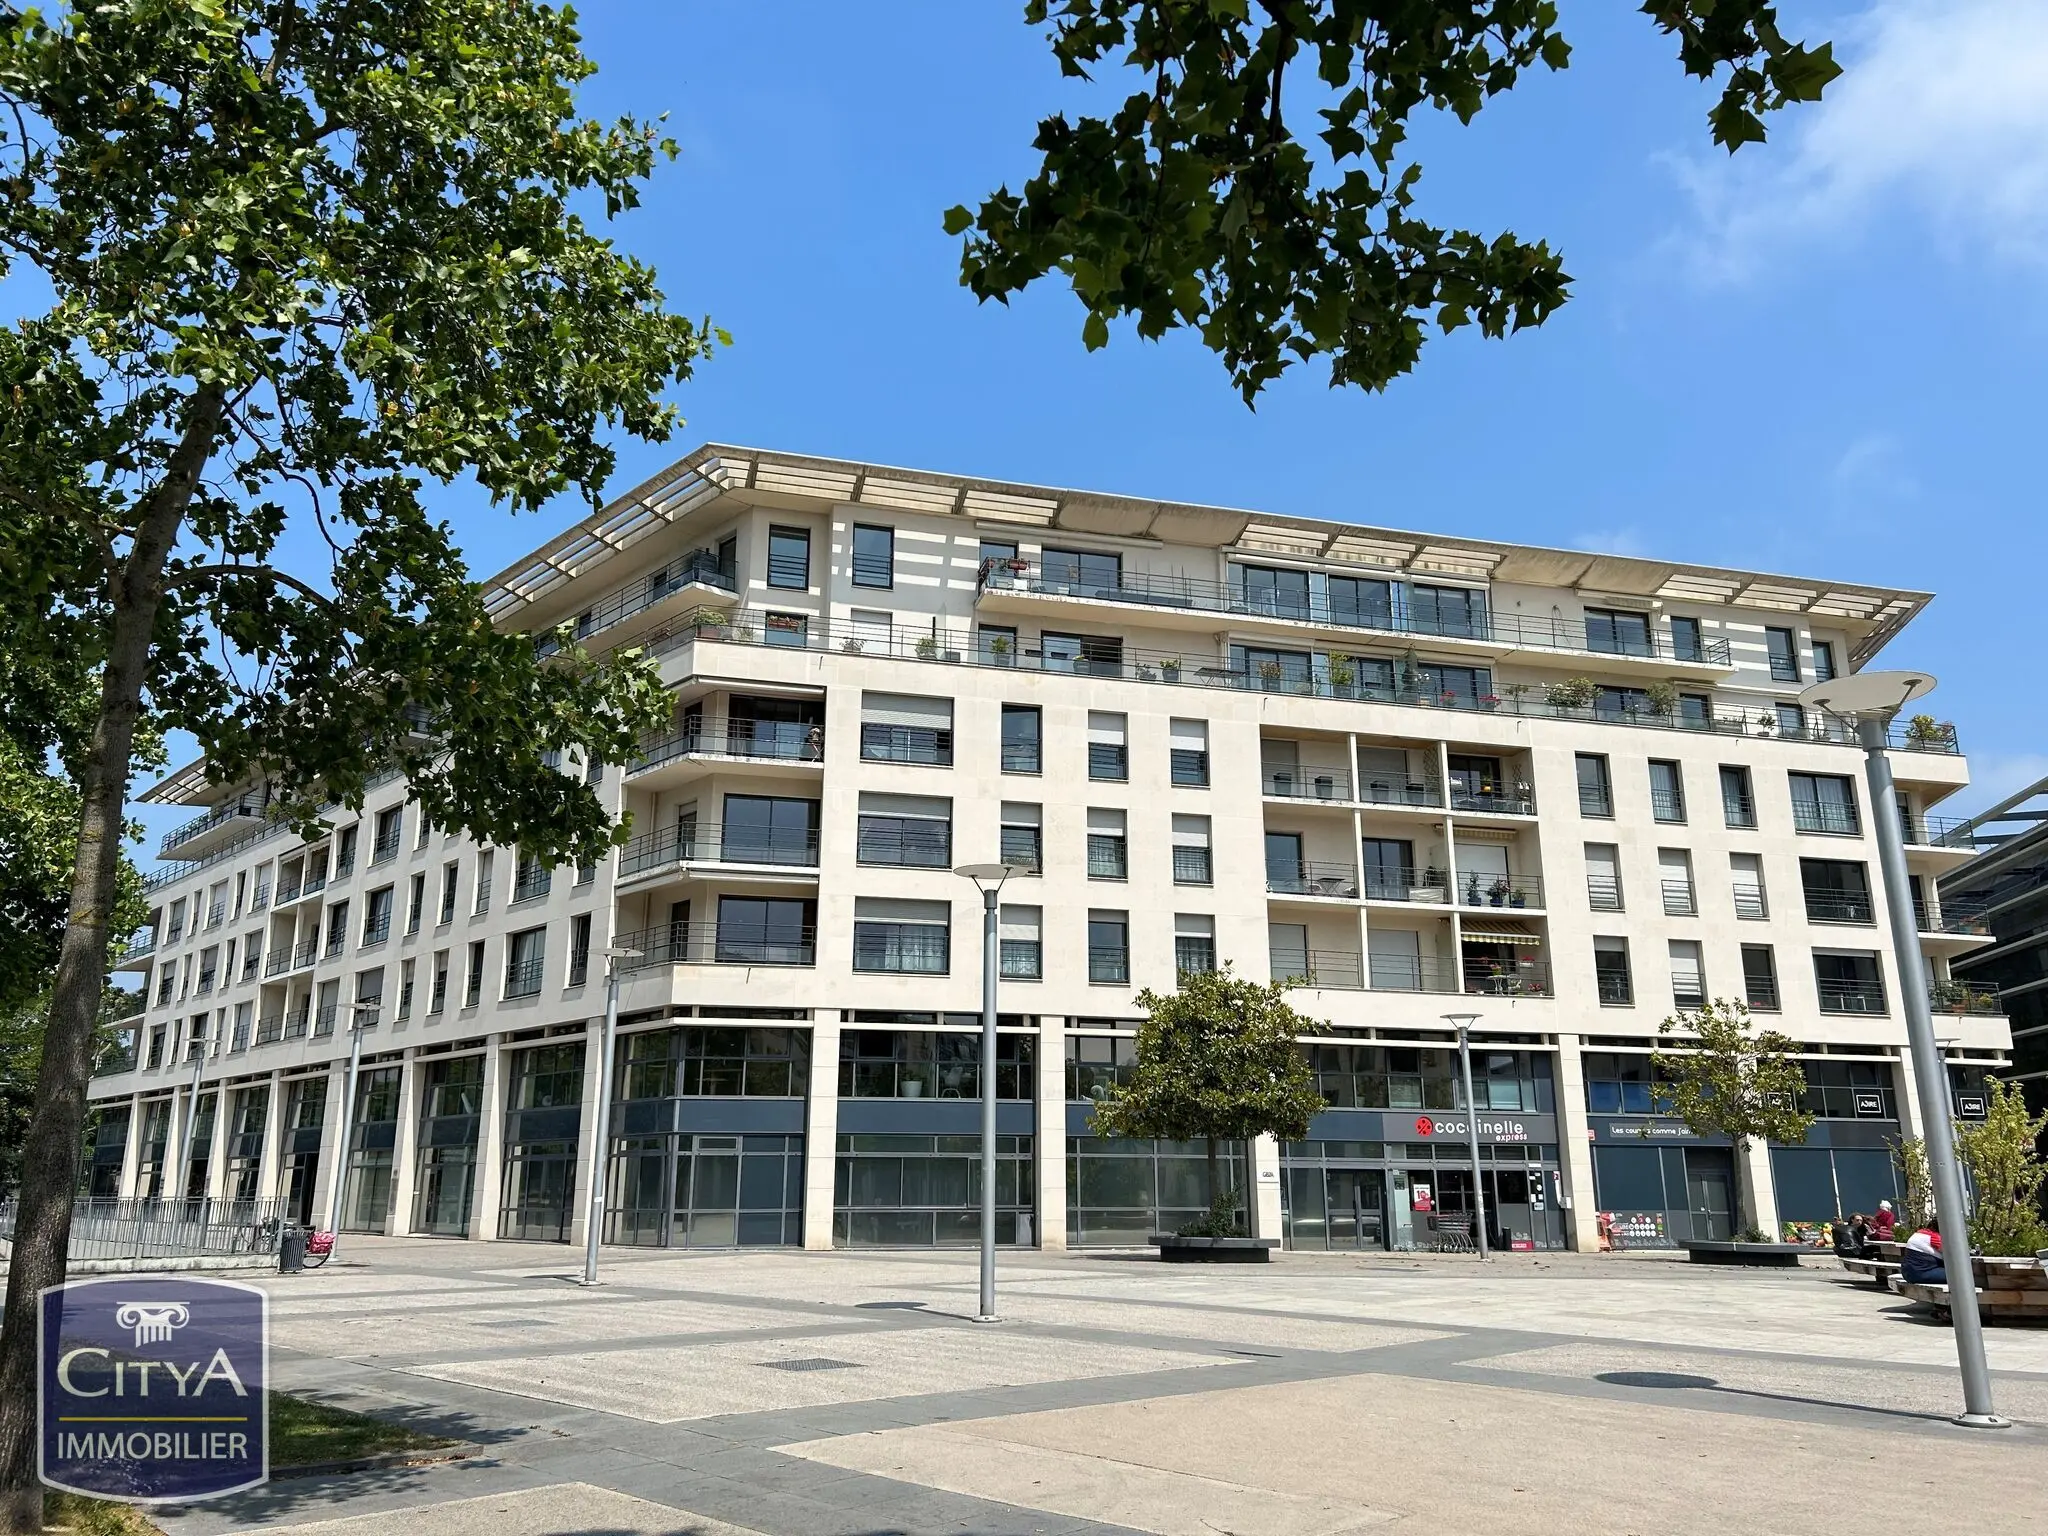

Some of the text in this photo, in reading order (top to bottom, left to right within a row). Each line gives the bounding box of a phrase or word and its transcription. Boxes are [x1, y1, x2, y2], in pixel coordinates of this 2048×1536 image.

[1434, 1118, 1524, 1134] cocinelle
[1611, 1126, 1624, 1134] Les
[1625, 1127, 1651, 1135] cours
[1652, 1127, 1676, 1135] comme
[1495, 1133, 1528, 1142] express
